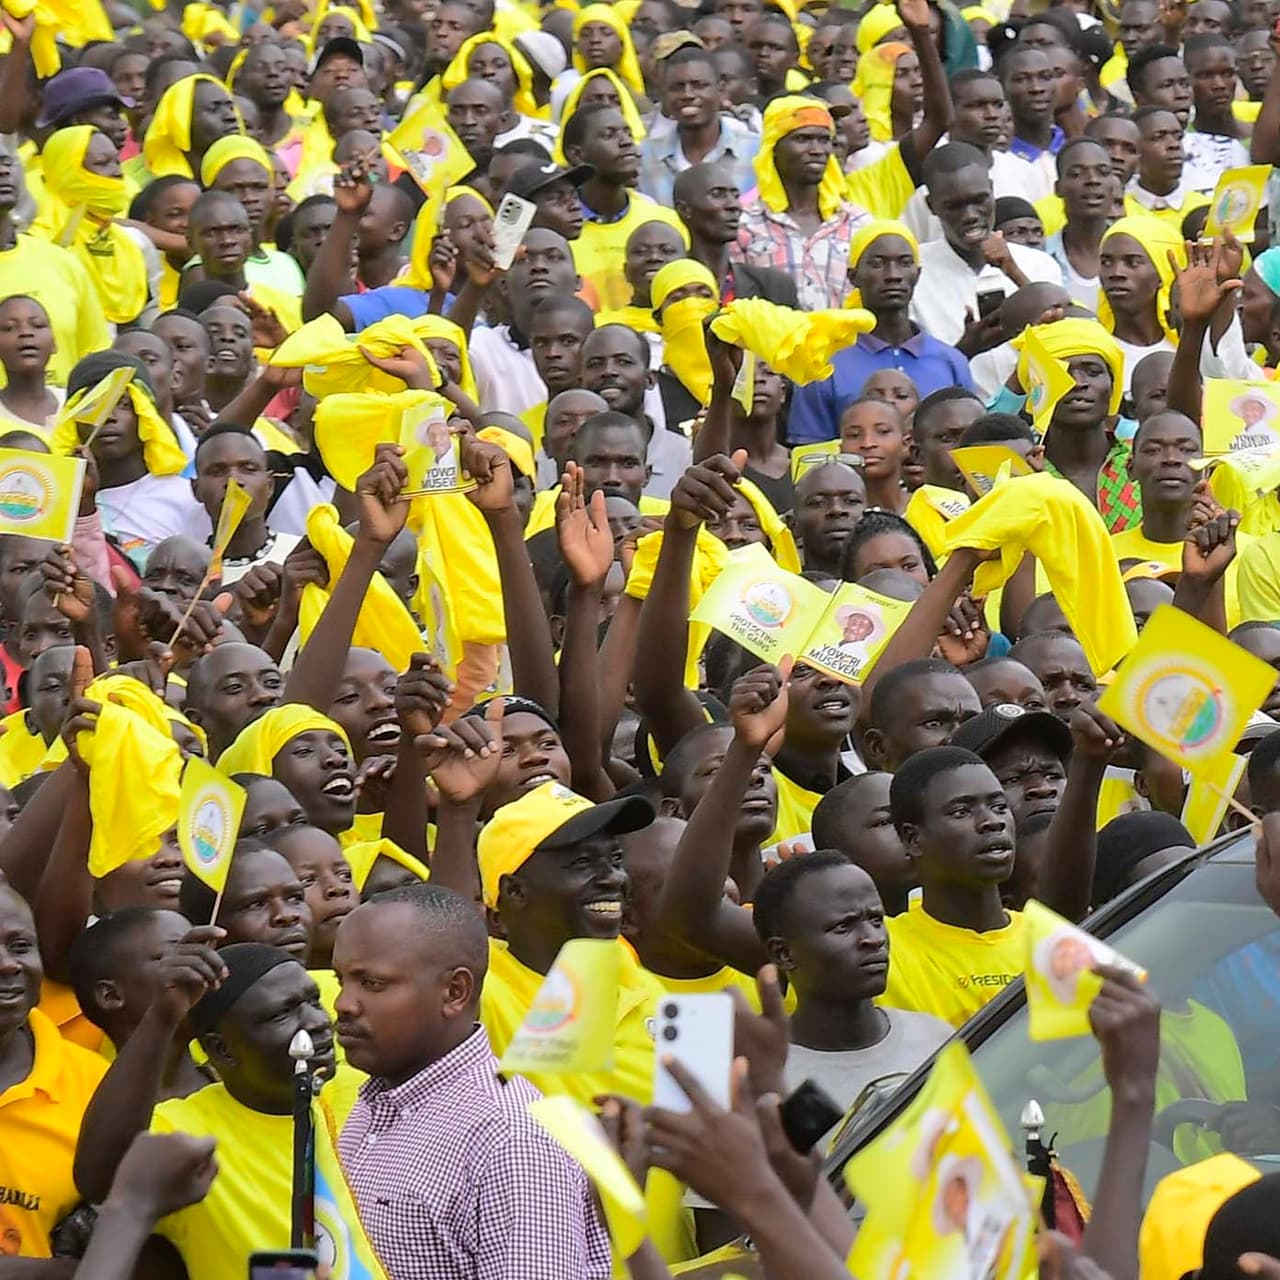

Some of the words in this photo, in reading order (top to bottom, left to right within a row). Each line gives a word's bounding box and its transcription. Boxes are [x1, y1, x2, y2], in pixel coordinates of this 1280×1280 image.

[729, 612, 778, 647] PROTECTING
[731, 622, 746, 638] THE
[747, 632, 770, 652] GAINS
[809, 647, 861, 677] MUSEVENI
[823, 643, 861, 667] YOWERI
